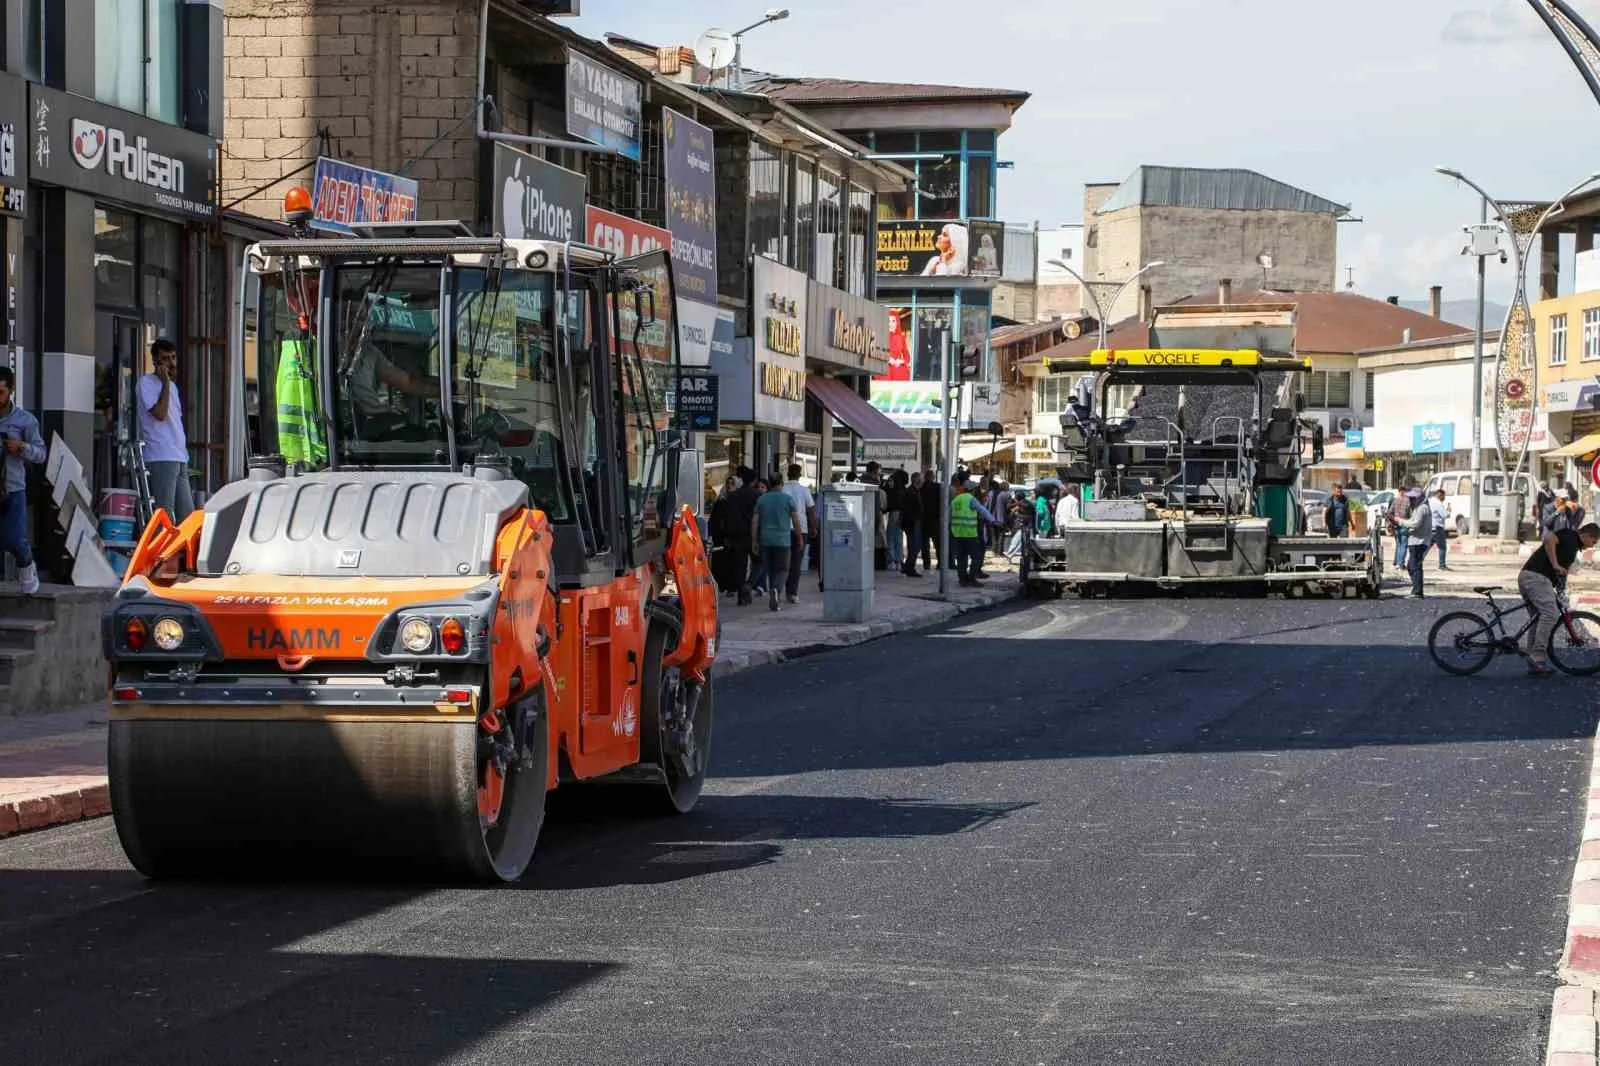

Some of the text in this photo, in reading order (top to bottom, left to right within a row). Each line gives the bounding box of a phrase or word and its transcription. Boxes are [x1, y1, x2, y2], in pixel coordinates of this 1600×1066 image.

[586, 66, 623, 106] YAŞAR
[106, 126, 185, 193] Polisan
[314, 175, 360, 225] ADEM
[526, 175, 573, 241] iPhone
[1144, 351, 1200, 364] VÖGELE
[215, 595, 233, 604] 25
[235, 596, 250, 604] M
[251, 596, 300, 605] FAZLA
[247, 627, 341, 650] HAMM
